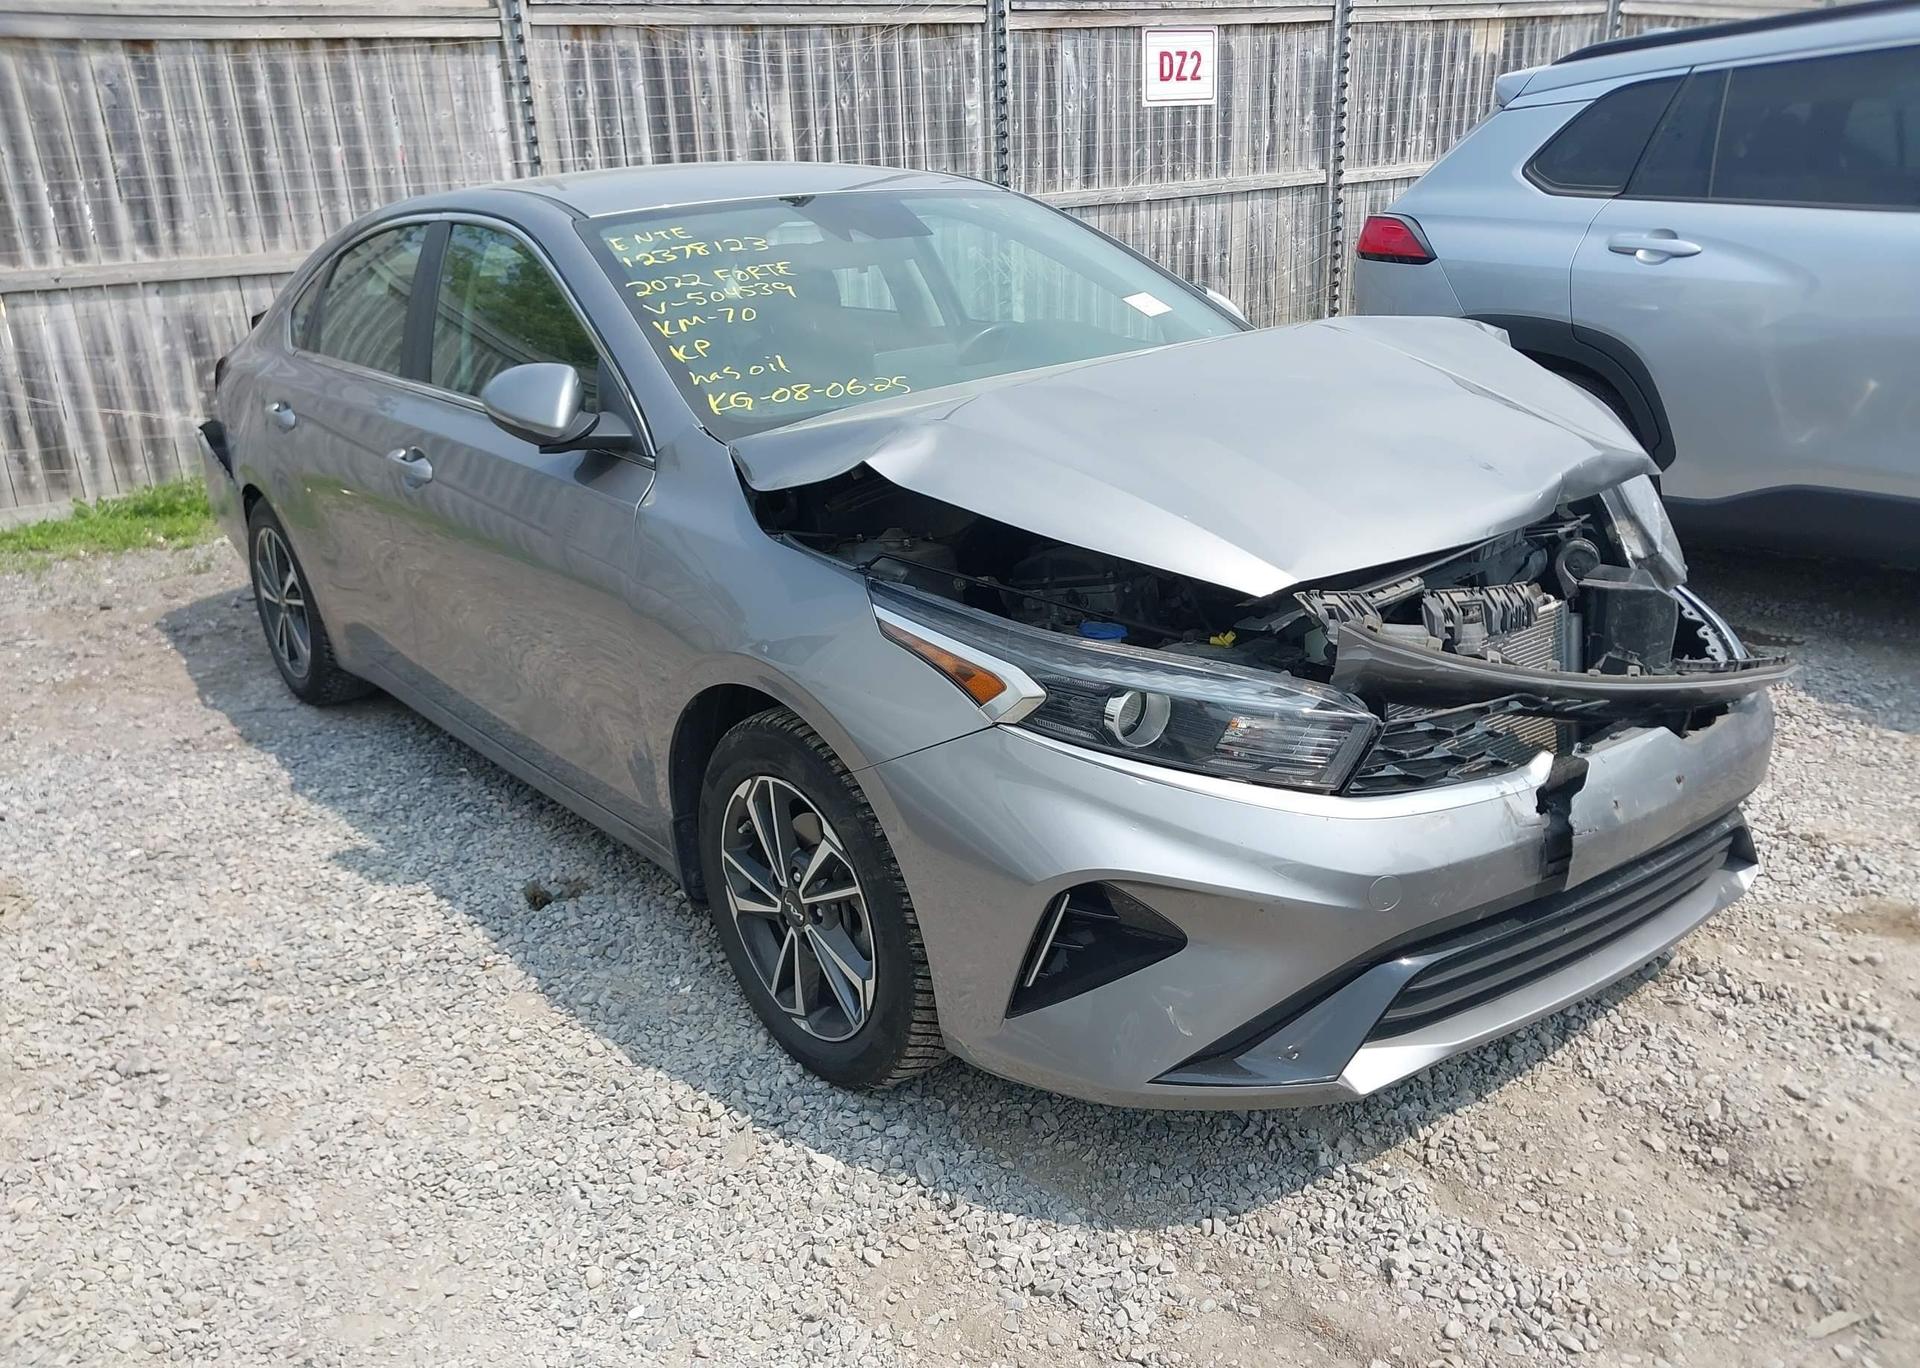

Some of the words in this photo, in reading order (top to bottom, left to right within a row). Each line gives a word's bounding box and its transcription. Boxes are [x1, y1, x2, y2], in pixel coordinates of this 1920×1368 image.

[1159, 50, 1202, 82] DZ2
[622, 236, 769, 268] 12378123
[625, 274, 713, 297] 2022
[713, 261, 798, 281] FORTE
[668, 339, 711, 363] KP
[689, 366, 740, 385] has
[749, 354, 791, 375] oil
